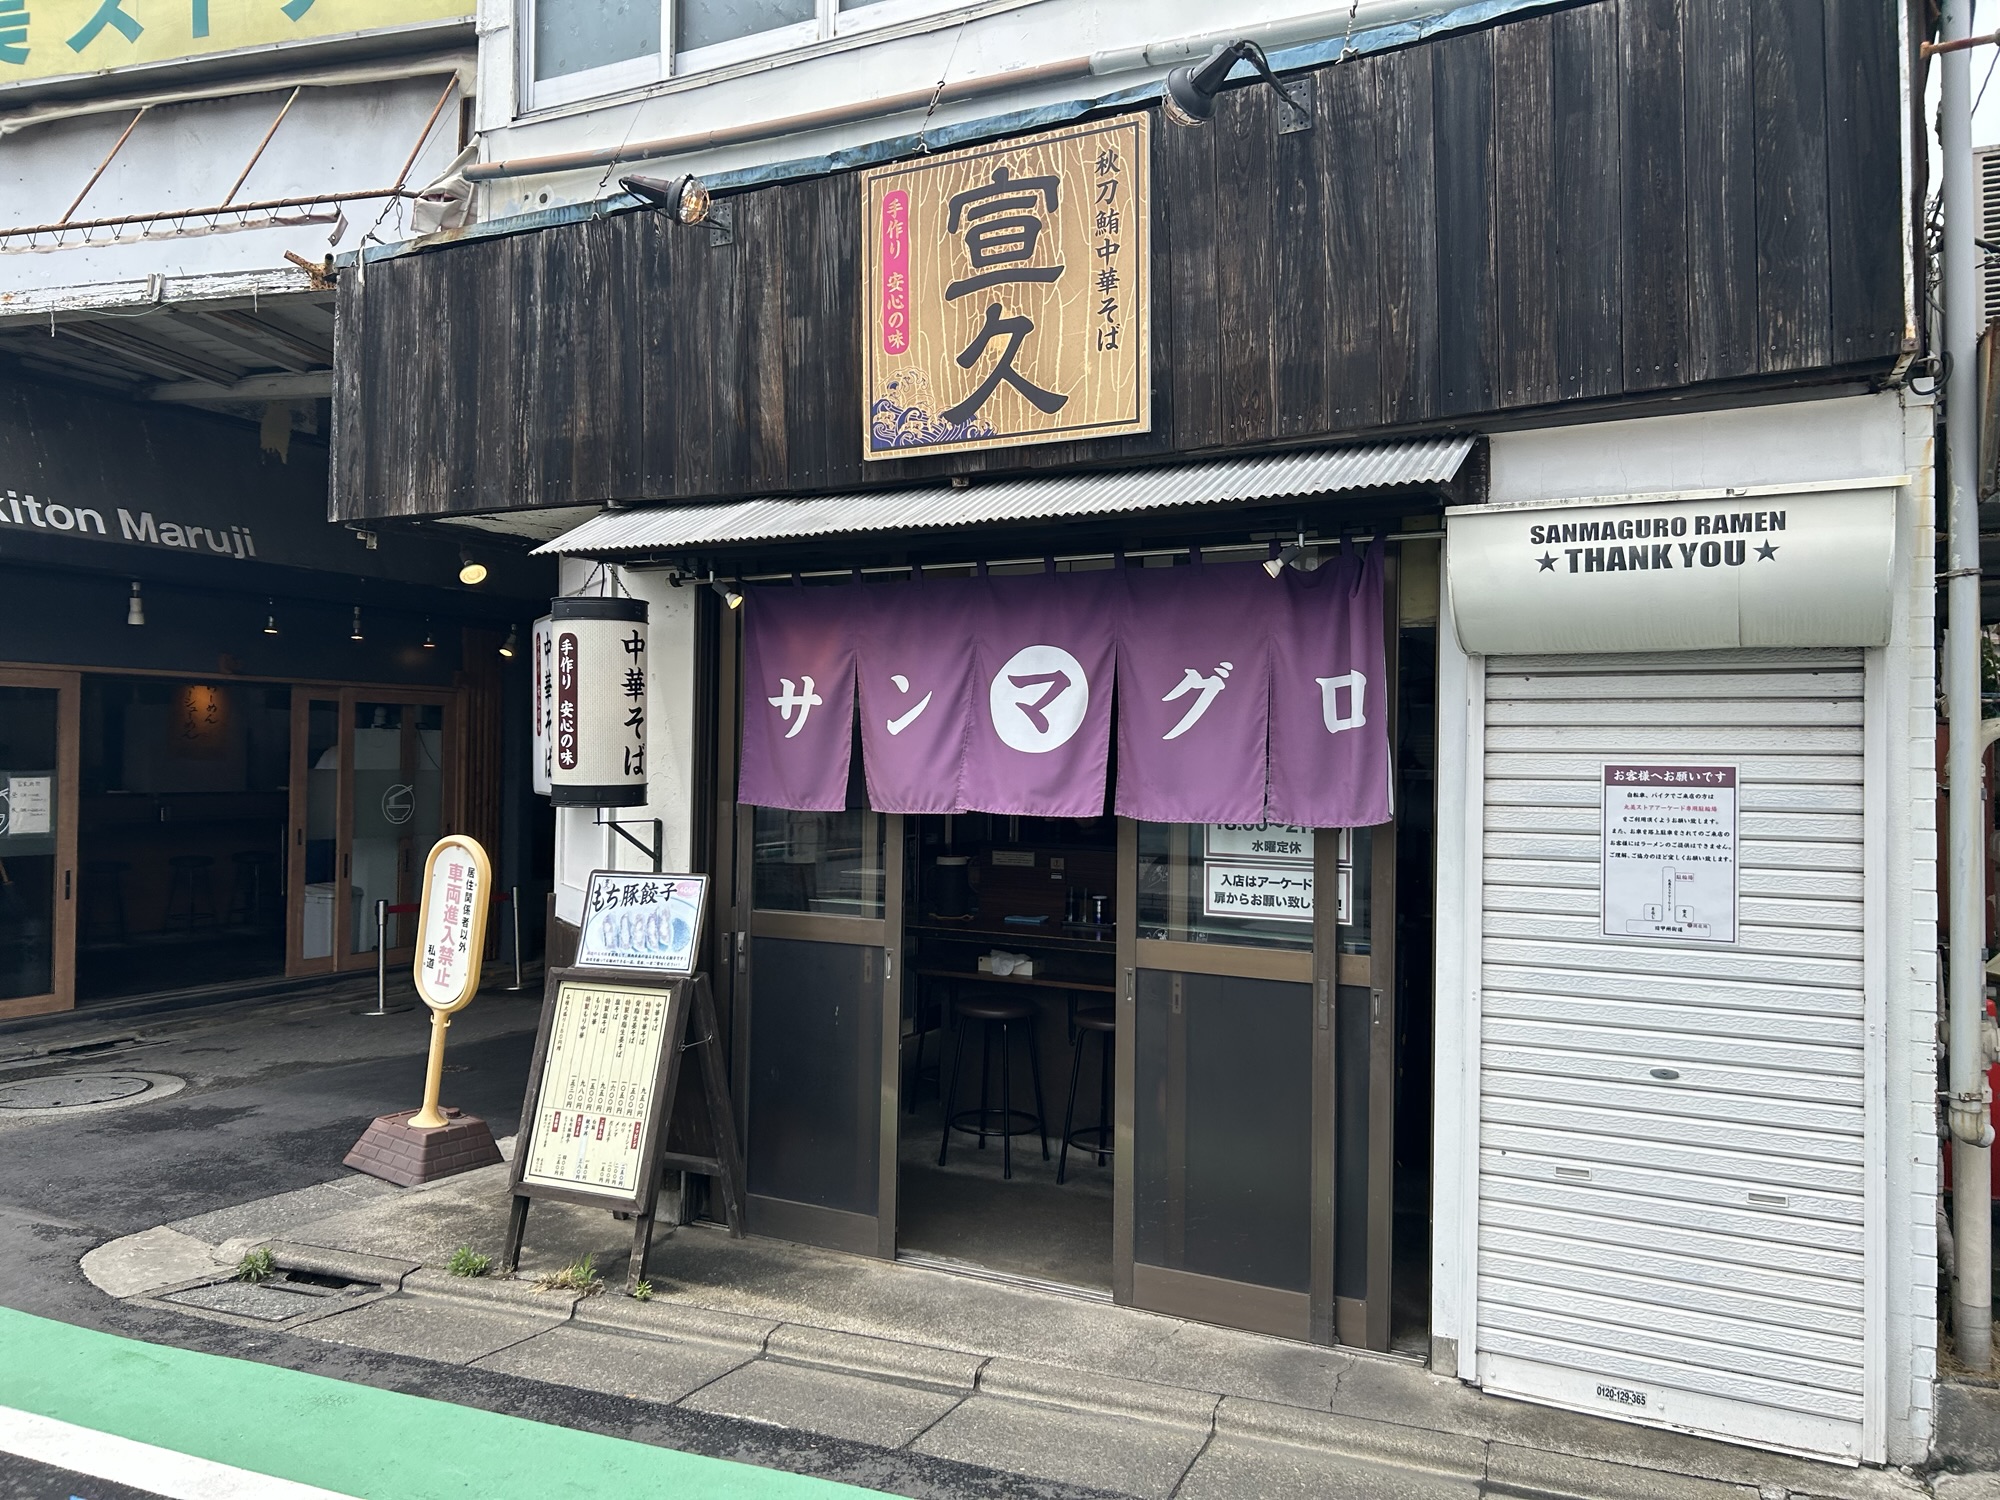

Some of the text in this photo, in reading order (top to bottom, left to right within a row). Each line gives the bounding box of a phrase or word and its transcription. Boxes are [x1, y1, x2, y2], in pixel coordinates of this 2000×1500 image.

[1094, 149, 1121, 352] 秋刀鮪中華そば
[886, 198, 905, 348] 手作り 安心の味
[945, 167, 1069, 422] 宣久
[116, 508, 257, 559] Maruji
[1530, 510, 1787, 545] SANMAGURO RAMEN
[1564, 539, 1746, 574] THANK YOU
[560, 638, 574, 766] 手作り 安心の味
[621, 629, 646, 776] 中華そば
[1613, 769, 1727, 783] お客様へお願いです
[1251, 840, 1302, 854] 水曜定休
[592, 881, 677, 912] もち豚餃子
[1220, 874, 1313, 890] 入店はアーケード
[434, 863, 464, 988] 車両進入禁止
[458, 867, 476, 953] 居住関係者以外
[426, 944, 436, 969] 私道
[638, 1001, 651, 1044] 特製中華そば
[651, 1001, 661, 1031] 中華そば
[1597, 1386, 1646, 1406] 0120-129-365
